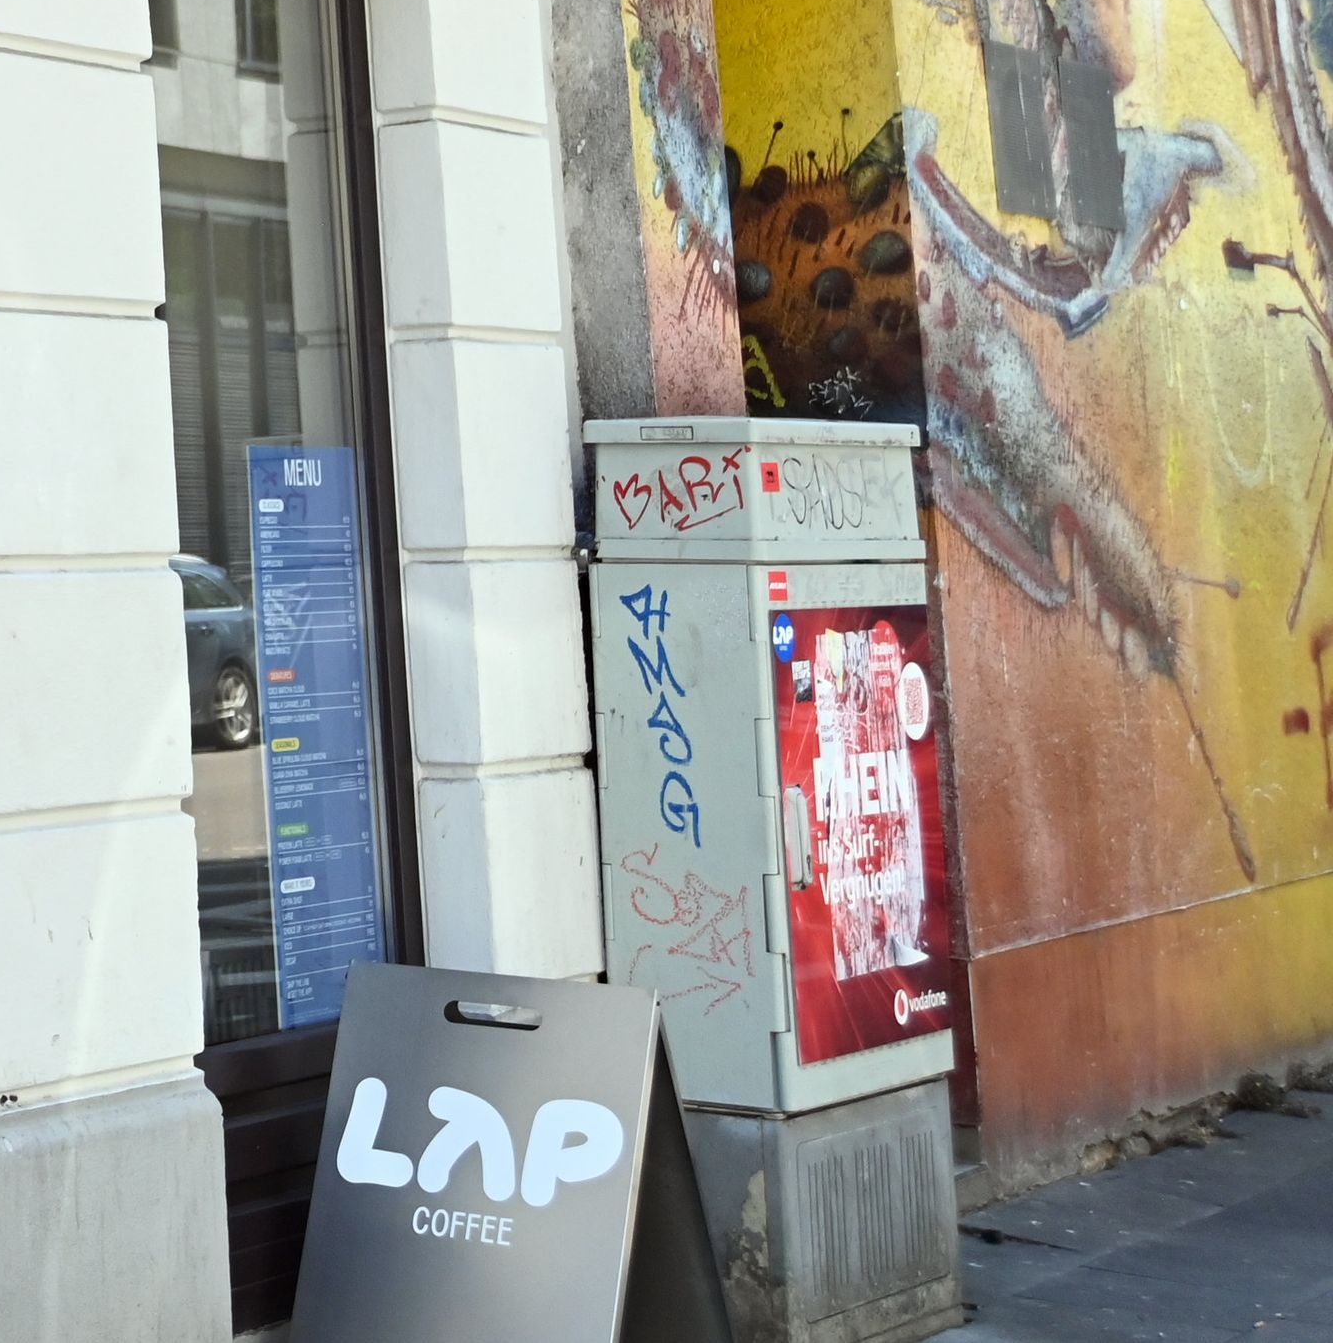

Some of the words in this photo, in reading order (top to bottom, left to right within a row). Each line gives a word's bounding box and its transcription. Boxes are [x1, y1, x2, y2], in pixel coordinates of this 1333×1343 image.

[283, 458, 322, 486] MENU
[772, 625, 794, 645] LAP
[819, 863, 906, 910] Vergnügen!
[908, 988, 947, 1013] vodafone
[336, 1077, 624, 1207] LAP
[412, 1206, 514, 1246] COFFEE
